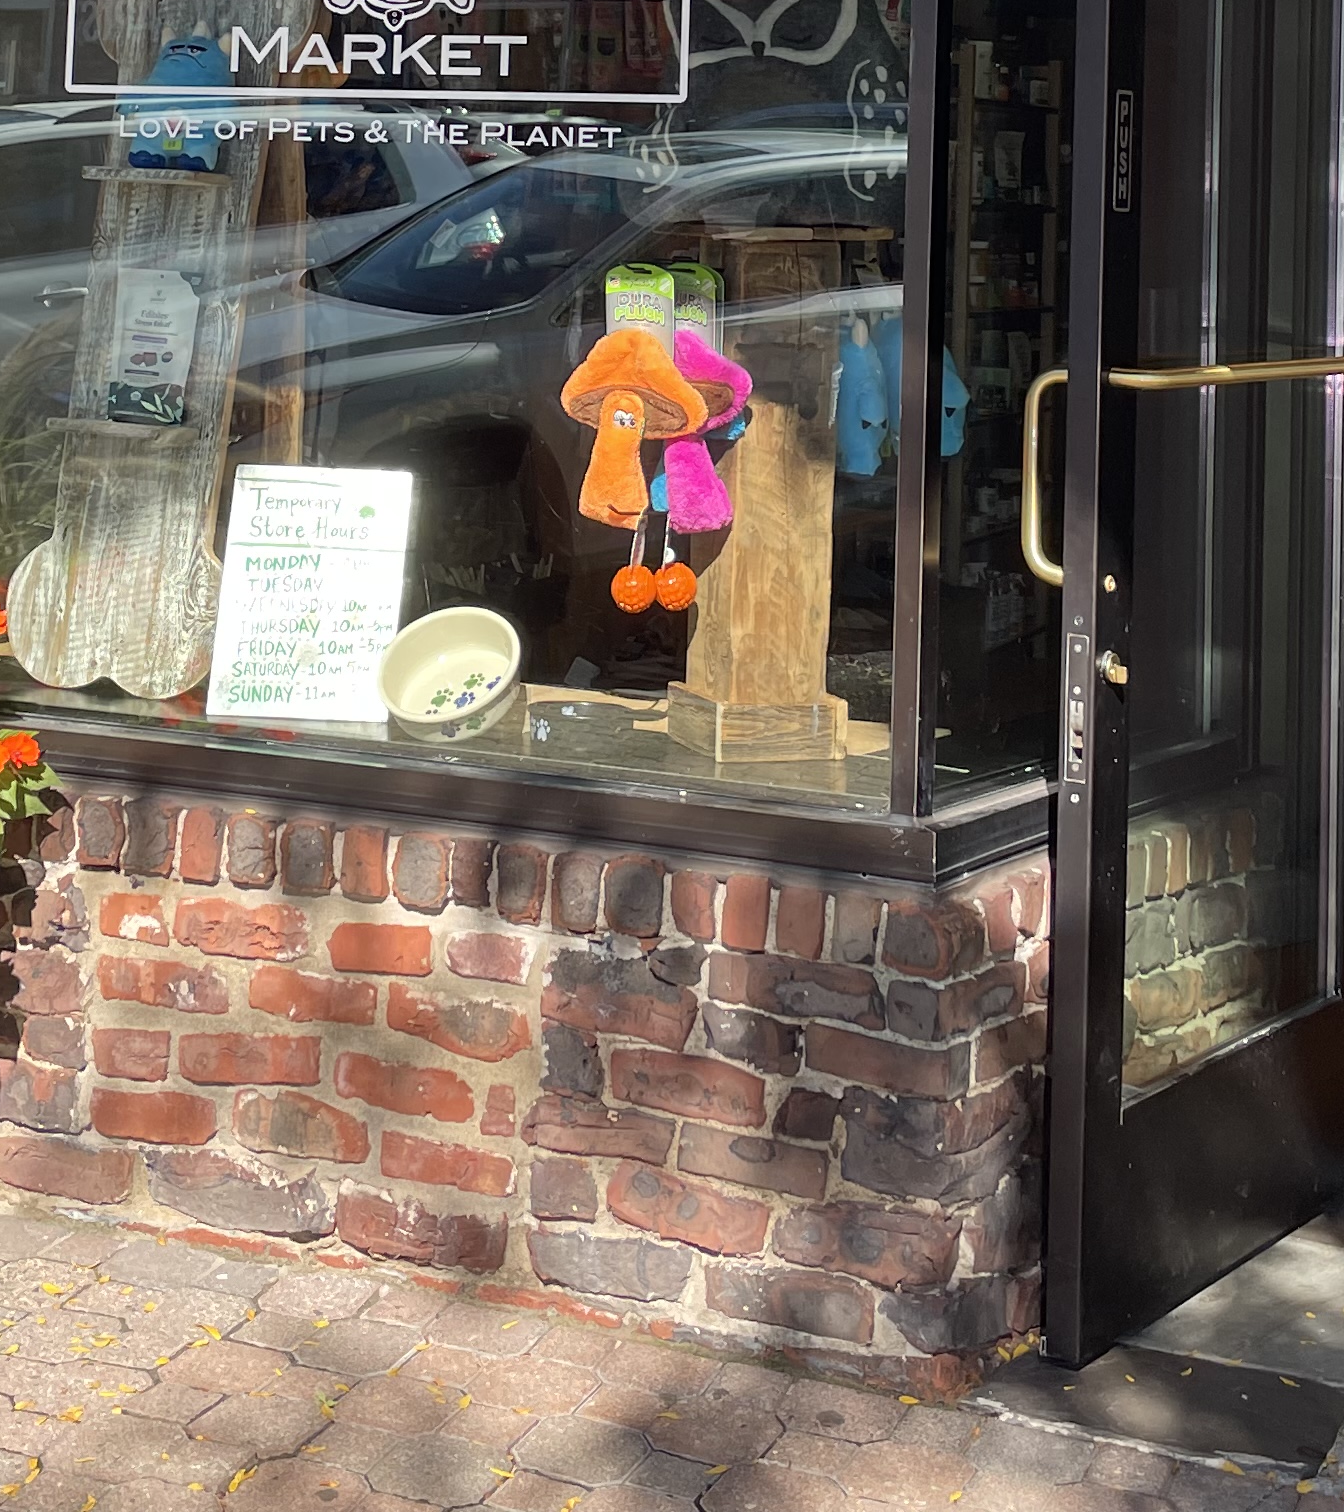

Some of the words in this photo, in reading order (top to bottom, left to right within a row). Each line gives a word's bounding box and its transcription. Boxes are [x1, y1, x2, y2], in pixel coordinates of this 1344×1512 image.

[229, 26, 528, 78] MARKET
[118, 116, 206, 141] LOVE
[214, 120, 254, 142] OF
[268, 118, 354, 144] PETS
[364, 120, 389, 145] &
[399, 118, 469, 147] THE
[480, 120, 623, 149] PLANET
[1117, 100, 1130, 200] PUSH
[249, 486, 342, 516] Temporary
[249, 515, 306, 538] Store
[314, 516, 369, 540] Hours
[246, 553, 321, 572] MONDAY
[241, 619, 321, 638] THURSDAY
[237, 640, 297, 658] FRIDAY
[228, 685, 293, 704] SUNDAY
